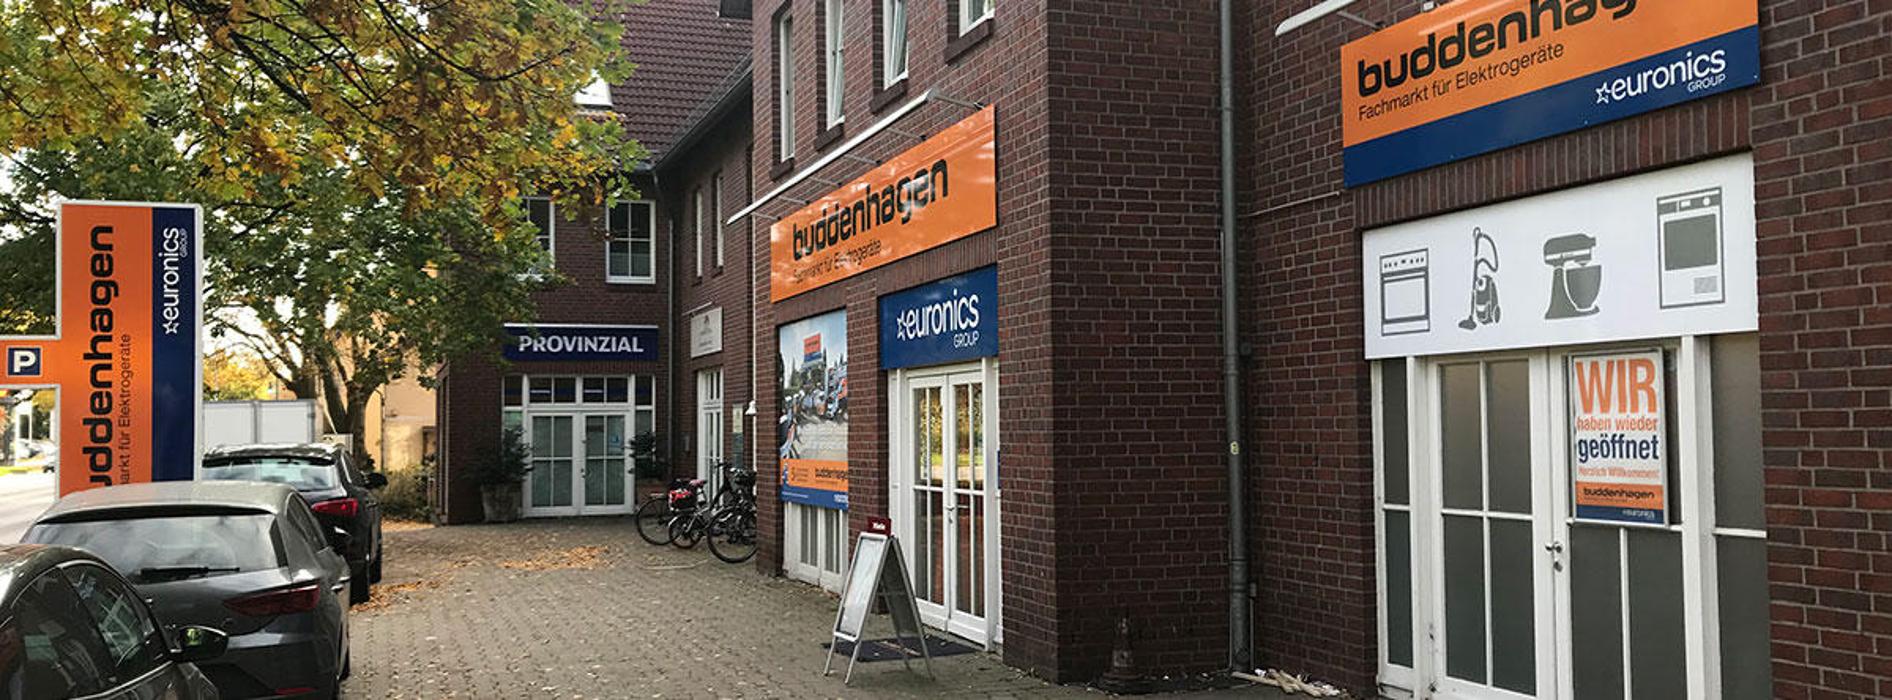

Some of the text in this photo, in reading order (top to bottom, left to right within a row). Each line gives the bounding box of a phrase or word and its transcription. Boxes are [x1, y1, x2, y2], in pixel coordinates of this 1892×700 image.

[1358, 42, 1564, 121] Fachmarkt für Elektrogeräte
[1611, 50, 1726, 101] euronics
[1687, 73, 1726, 92] GROUP
[793, 158, 948, 261] buddenhagen
[158, 227, 180, 321] euronics
[906, 288, 980, 340] euronics
[518, 335, 644, 352] PROVINZIAL
[953, 330, 979, 348] GROUP
[14, 350, 36, 373] P
[118, 334, 132, 427] Elektrogeräte
[1575, 358, 1657, 414] WIR
[1577, 416, 1658, 431] haben wieder
[1578, 434, 1659, 463] geöffnet
[118, 453, 130, 485] arkt
[1583, 487, 1655, 499] buddenhagen
